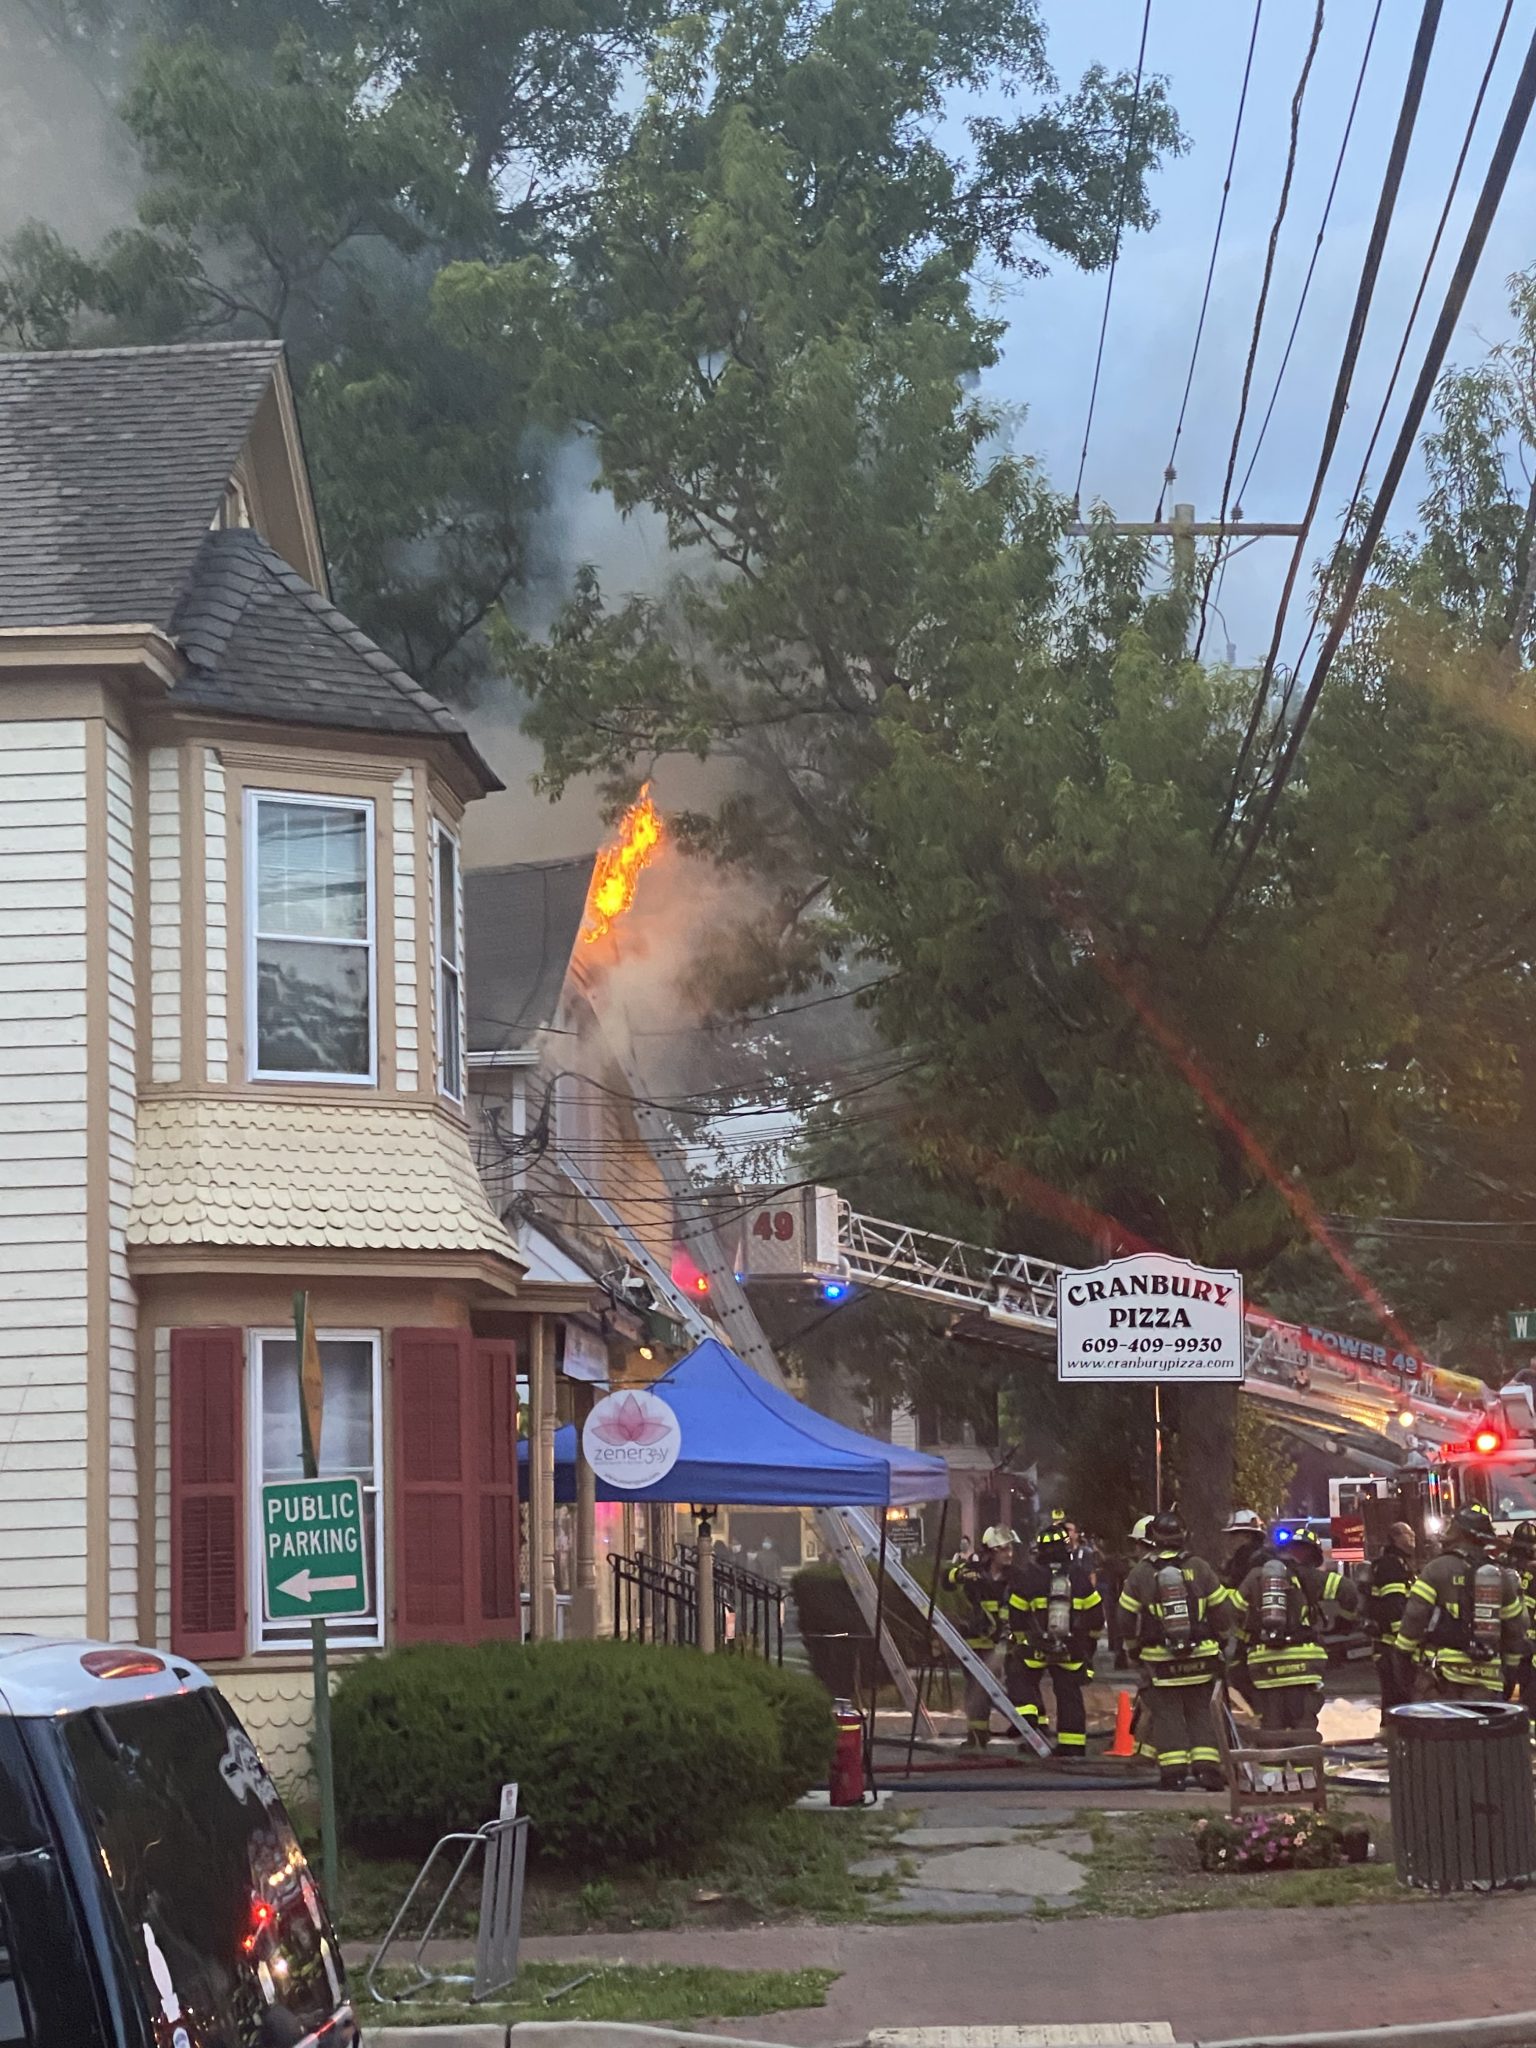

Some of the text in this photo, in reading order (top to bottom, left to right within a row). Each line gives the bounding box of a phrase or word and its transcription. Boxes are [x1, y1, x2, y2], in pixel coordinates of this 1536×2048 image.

[753, 1211, 794, 1241] 49
[1067, 1275, 1233, 1306] CRANBURY
[1108, 1307, 1192, 1328] PIZZA
[1081, 1338, 1222, 1353] 609-409-9930
[1307, 1327, 1418, 1375] TOWER 49
[1067, 1357, 1234, 1371] www.cranburypizza.com
[267, 1492, 355, 1524] PUBLIC
[268, 1527, 358, 1559] PARKING
